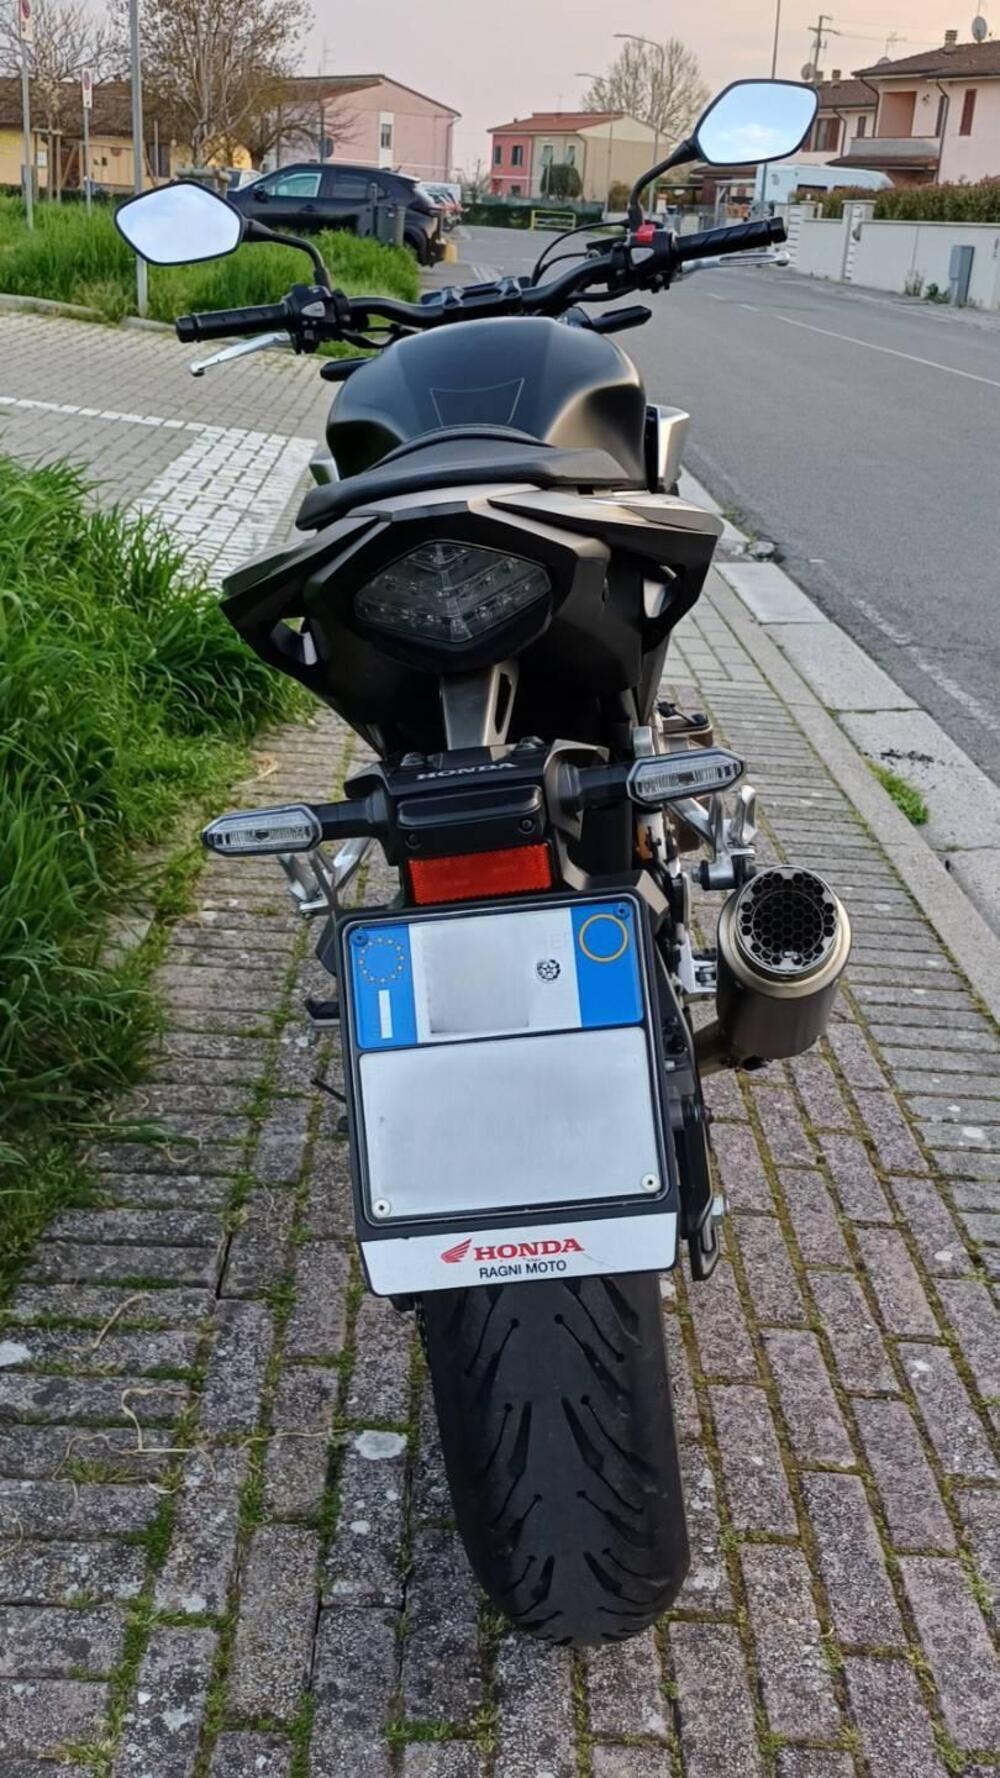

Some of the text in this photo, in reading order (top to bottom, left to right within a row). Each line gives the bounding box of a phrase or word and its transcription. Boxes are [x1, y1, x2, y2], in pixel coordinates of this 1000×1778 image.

[415, 761, 519, 780] HONDA
[473, 1238, 585, 1261] HONDA
[479, 1260, 567, 1279] RAGNI MOTO
